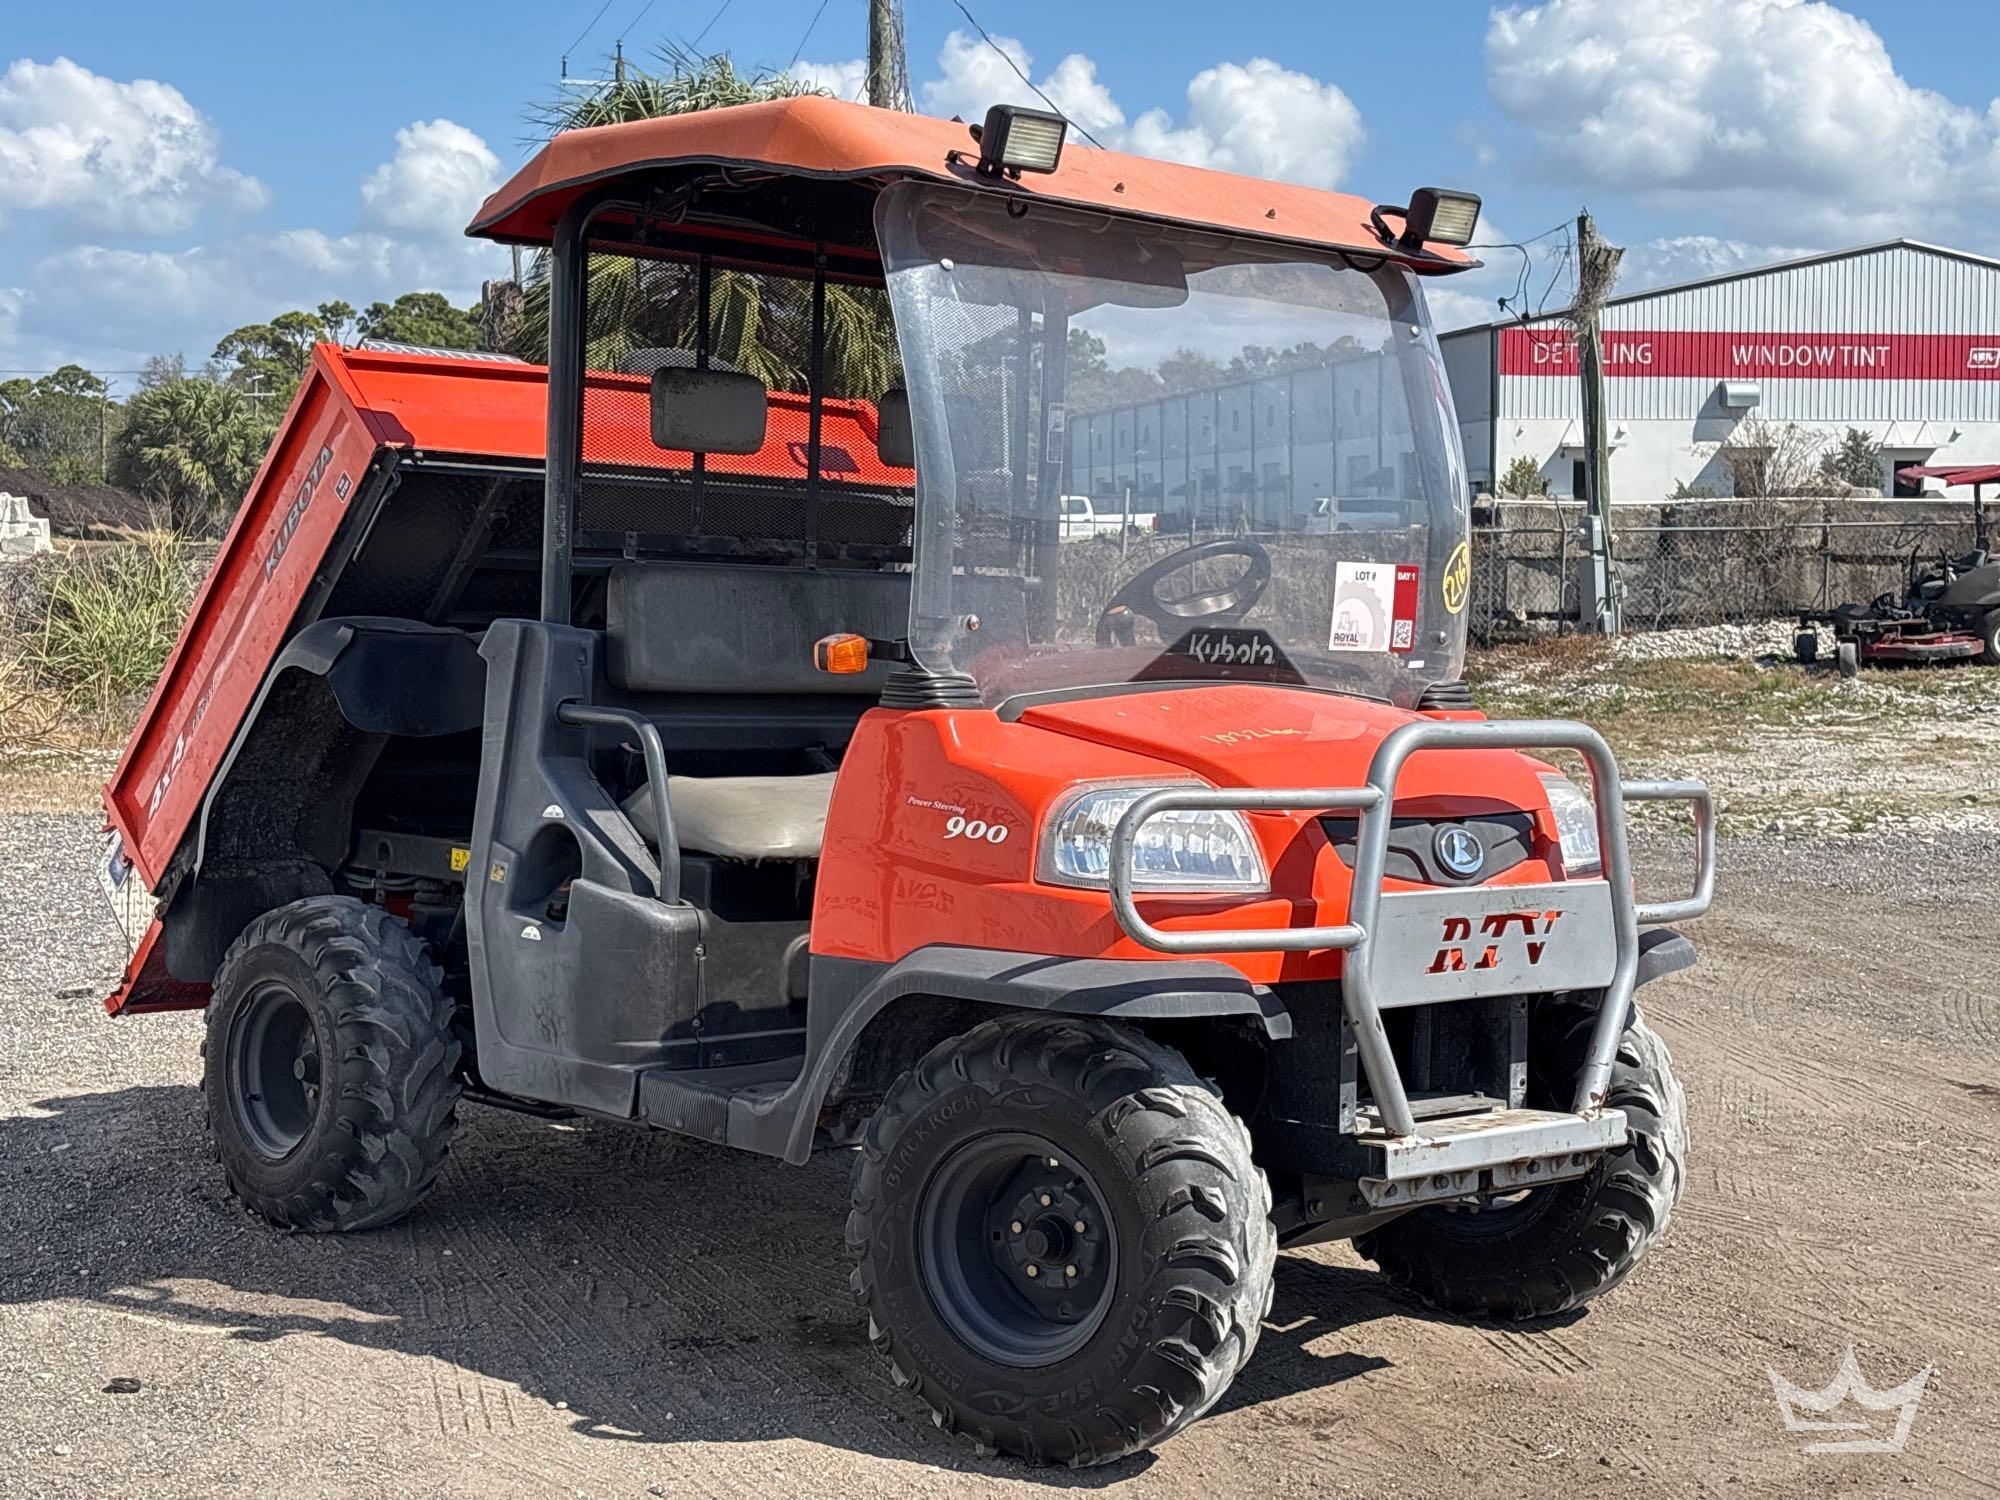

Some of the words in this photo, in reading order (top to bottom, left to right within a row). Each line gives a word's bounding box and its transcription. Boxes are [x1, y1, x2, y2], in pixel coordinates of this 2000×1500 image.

[1533, 342, 1652, 365] DETLING
[1731, 344, 1836, 367] WINDOW
[1840, 345, 1890, 368] TINT
[264, 444, 334, 583] KUBOTA
[1355, 571, 1371, 581] LOT
[1371, 571, 1377, 581] #
[1397, 572, 1411, 581] DAY
[1411, 572, 1416, 581] 1
[1188, 633, 1275, 665] Kubota
[1333, 632, 1359, 643] ROYAL
[907, 795, 932, 808] Power
[932, 800, 966, 815] Steering
[942, 815, 1009, 844] 900
[1424, 910, 1563, 975] RTV
[887, 1124, 932, 1189] BLACK
[926, 1093, 980, 1134] ROCK
